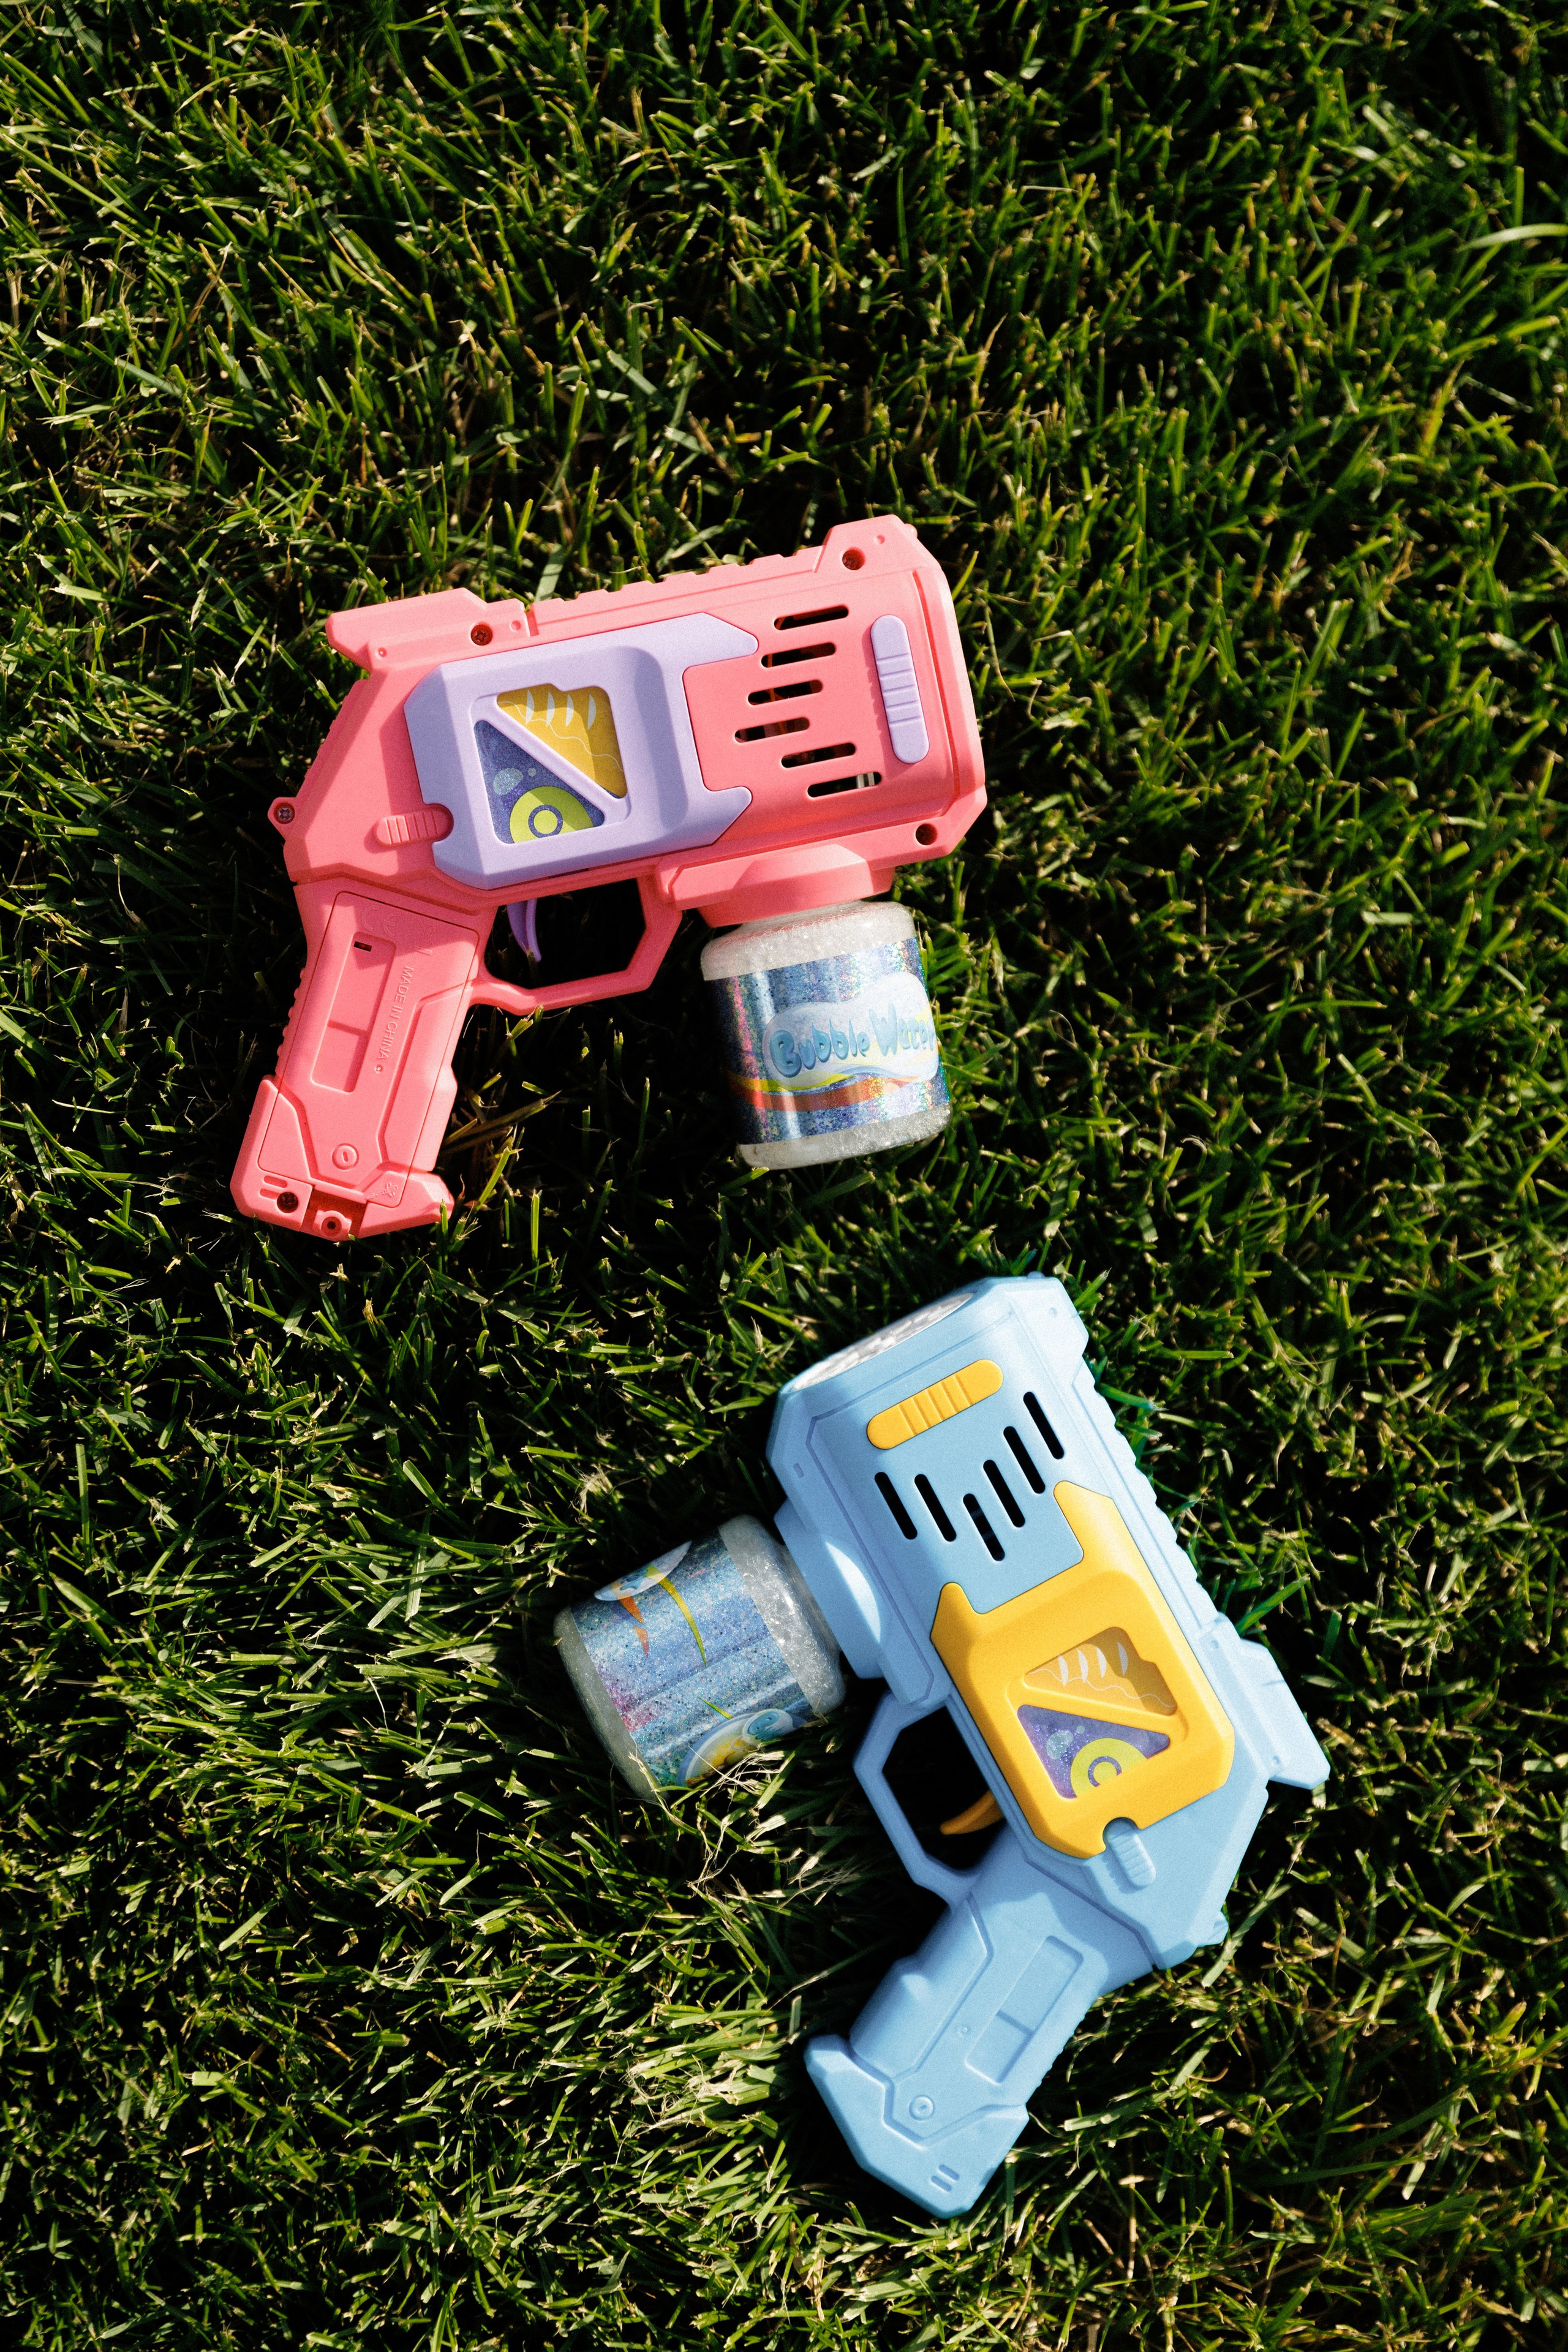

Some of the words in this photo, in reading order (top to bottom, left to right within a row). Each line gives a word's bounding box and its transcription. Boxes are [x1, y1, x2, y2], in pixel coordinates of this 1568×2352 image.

[361, 905, 400, 938] CE
[395, 966, 414, 1003] MADE
[390, 1006, 403, 1019] IN
[378, 1022, 398, 1059] CHINA
[770, 1019, 870, 1078] Bubble
[869, 1003, 935, 1057] Water
